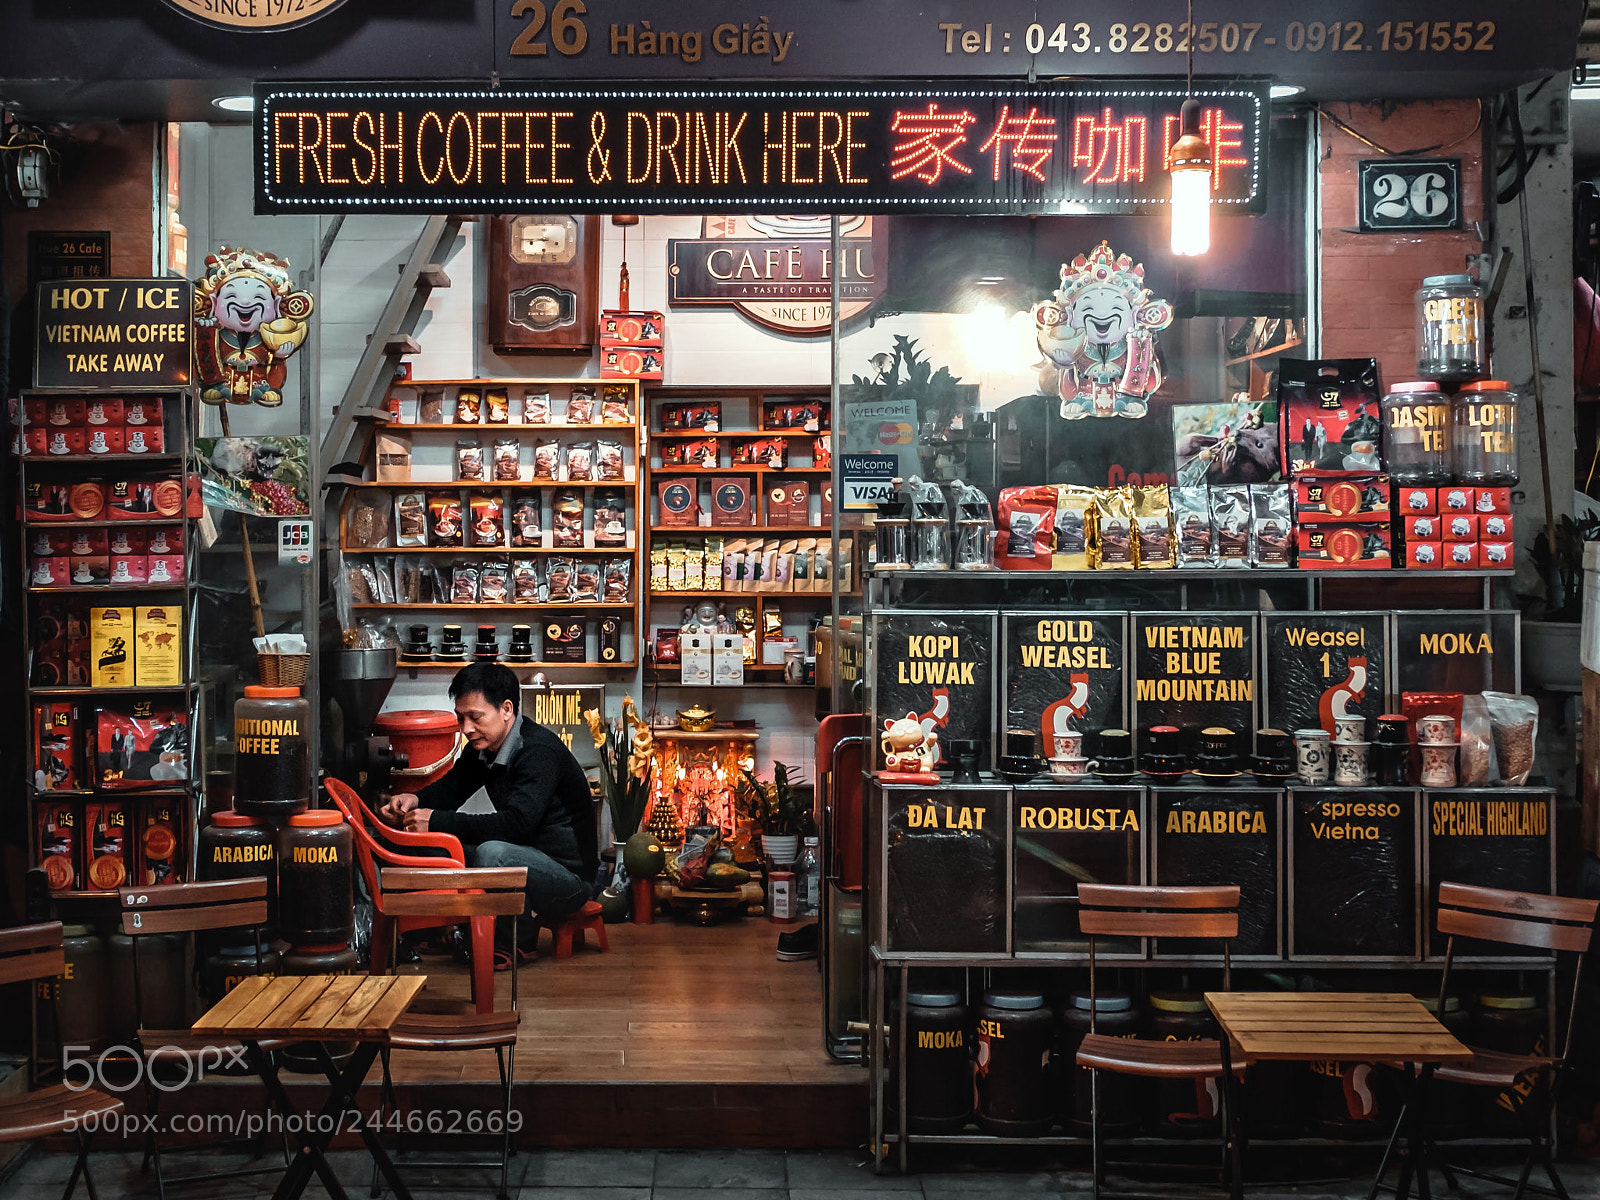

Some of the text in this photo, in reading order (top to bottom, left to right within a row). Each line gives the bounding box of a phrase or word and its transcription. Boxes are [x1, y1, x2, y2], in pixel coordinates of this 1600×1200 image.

[510, 0, 794, 63] 26 Hàng Giầy
[938, 23, 991, 54] Tel
[273, 112, 870, 185] FRESH COFFEE & DRINK HERE
[1371, 172, 1450, 217] 26
[62, 242, 76, 255] 26
[79, 242, 103, 255] Cafe
[706, 245, 804, 280] CAFÉ
[51, 287, 180, 312] HOT / ICE
[742, 286, 748, 294] A
[753, 286, 785, 294] TASTE
[790, 286, 803, 294] OF
[771, 307, 807, 322] SINCE
[45, 324, 186, 344] VIETNAM COFFEE
[66, 353, 165, 373] TAKE AWAY
[850, 405, 912, 418] WELCOME
[844, 458, 894, 470] Welcome
[850, 486, 889, 500] VISA
[282, 531, 309, 539] JCB
[1037, 620, 1093, 643] GOLD
[1145, 626, 1244, 649] VIETNAM
[1285, 627, 1365, 648] Weasel
[908, 635, 959, 658] KOPI
[1420, 632, 1494, 655] MOKA
[1021, 645, 1112, 669] WEASEL
[1166, 652, 1221, 675] BLUE
[1319, 652, 1331, 678] 1
[898, 661, 975, 685] LUWAK
[1136, 678, 1253, 702] MOUNTAIN
[1020, 806, 1140, 832] ROBUSTA
[1166, 811, 1268, 834] ARABICA
[1322, 803, 1401, 821] spresso
[1433, 801, 1547, 836] SPECIAL HIGHLAND
[213, 844, 274, 863] ARABICA
[293, 846, 338, 864] MOKA
[918, 1030, 963, 1049] MOKA
